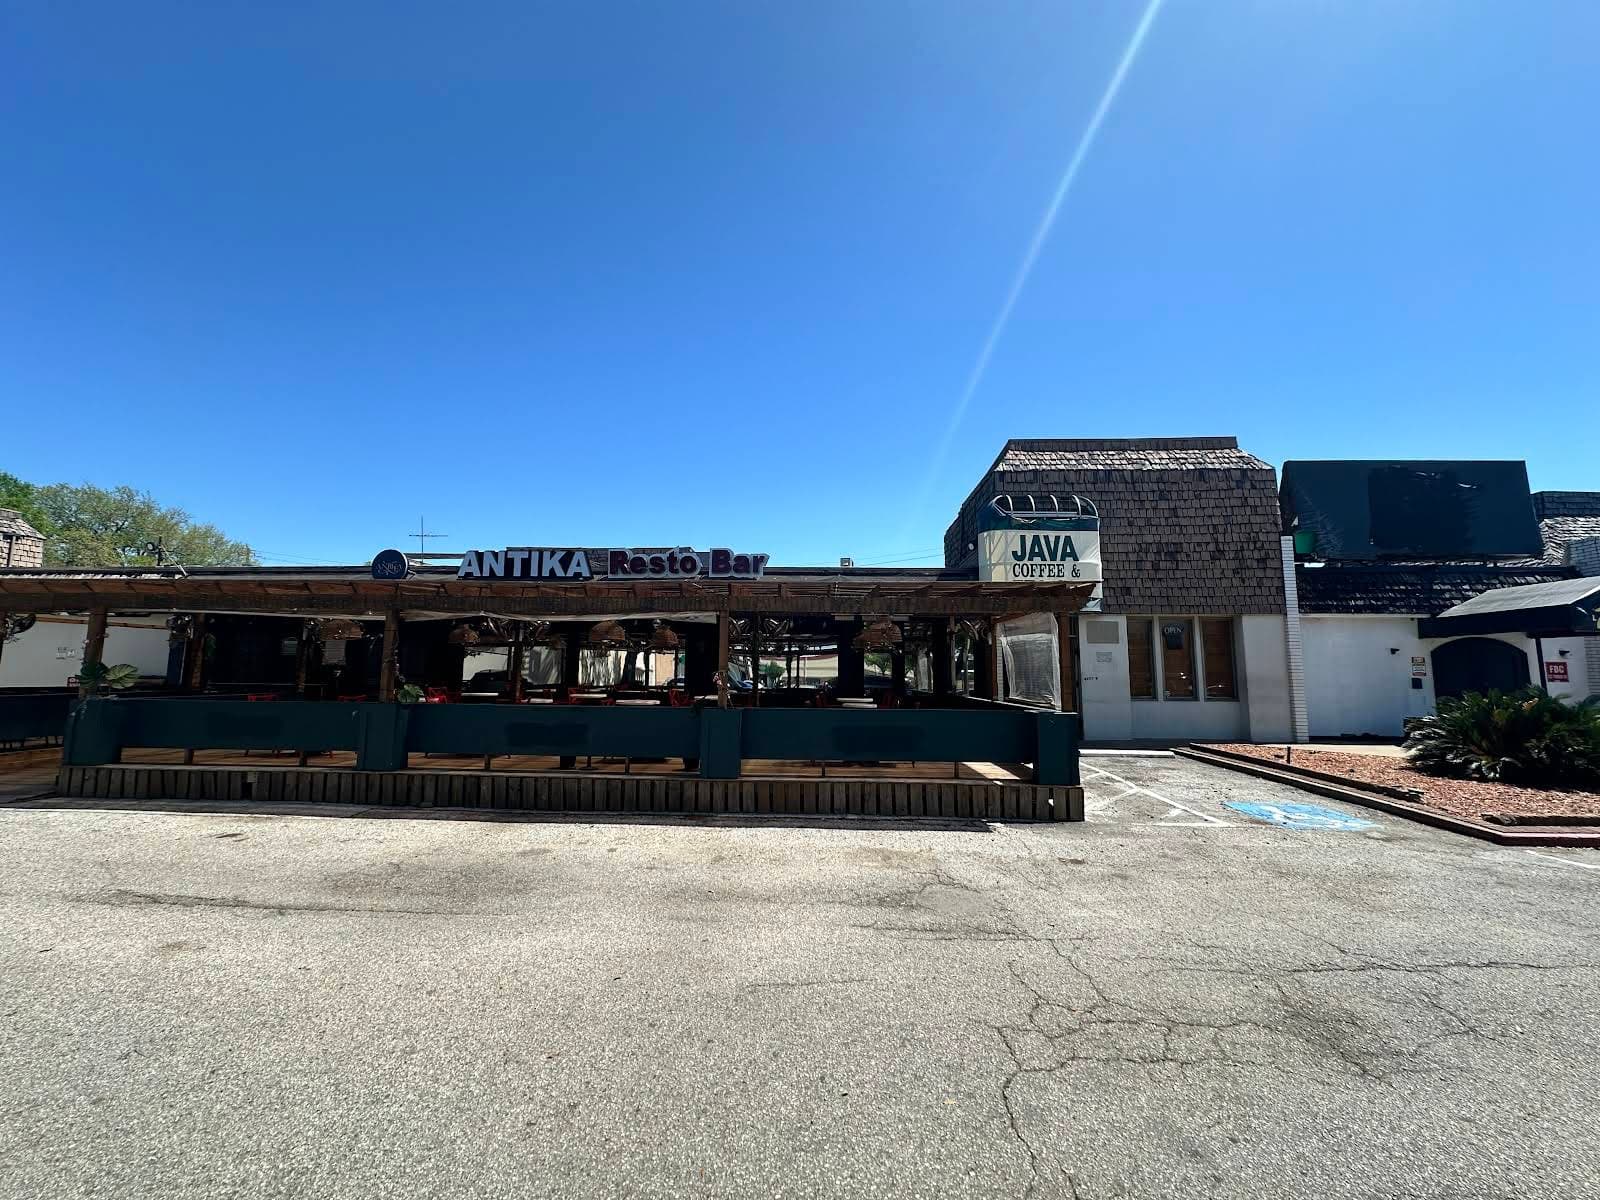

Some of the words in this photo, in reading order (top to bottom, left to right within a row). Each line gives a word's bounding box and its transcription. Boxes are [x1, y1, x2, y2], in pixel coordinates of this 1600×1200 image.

[1012, 535, 1079, 561] JAVA
[457, 550, 591, 577] ANTIKA
[608, 547, 703, 577] Resto
[709, 547, 769, 577] Bar
[1012, 563, 1065, 578] COFFEE
[1071, 563, 1081, 578] &
[1163, 625, 1183, 635] OPEN
[1549, 665, 1565, 674] FDC
